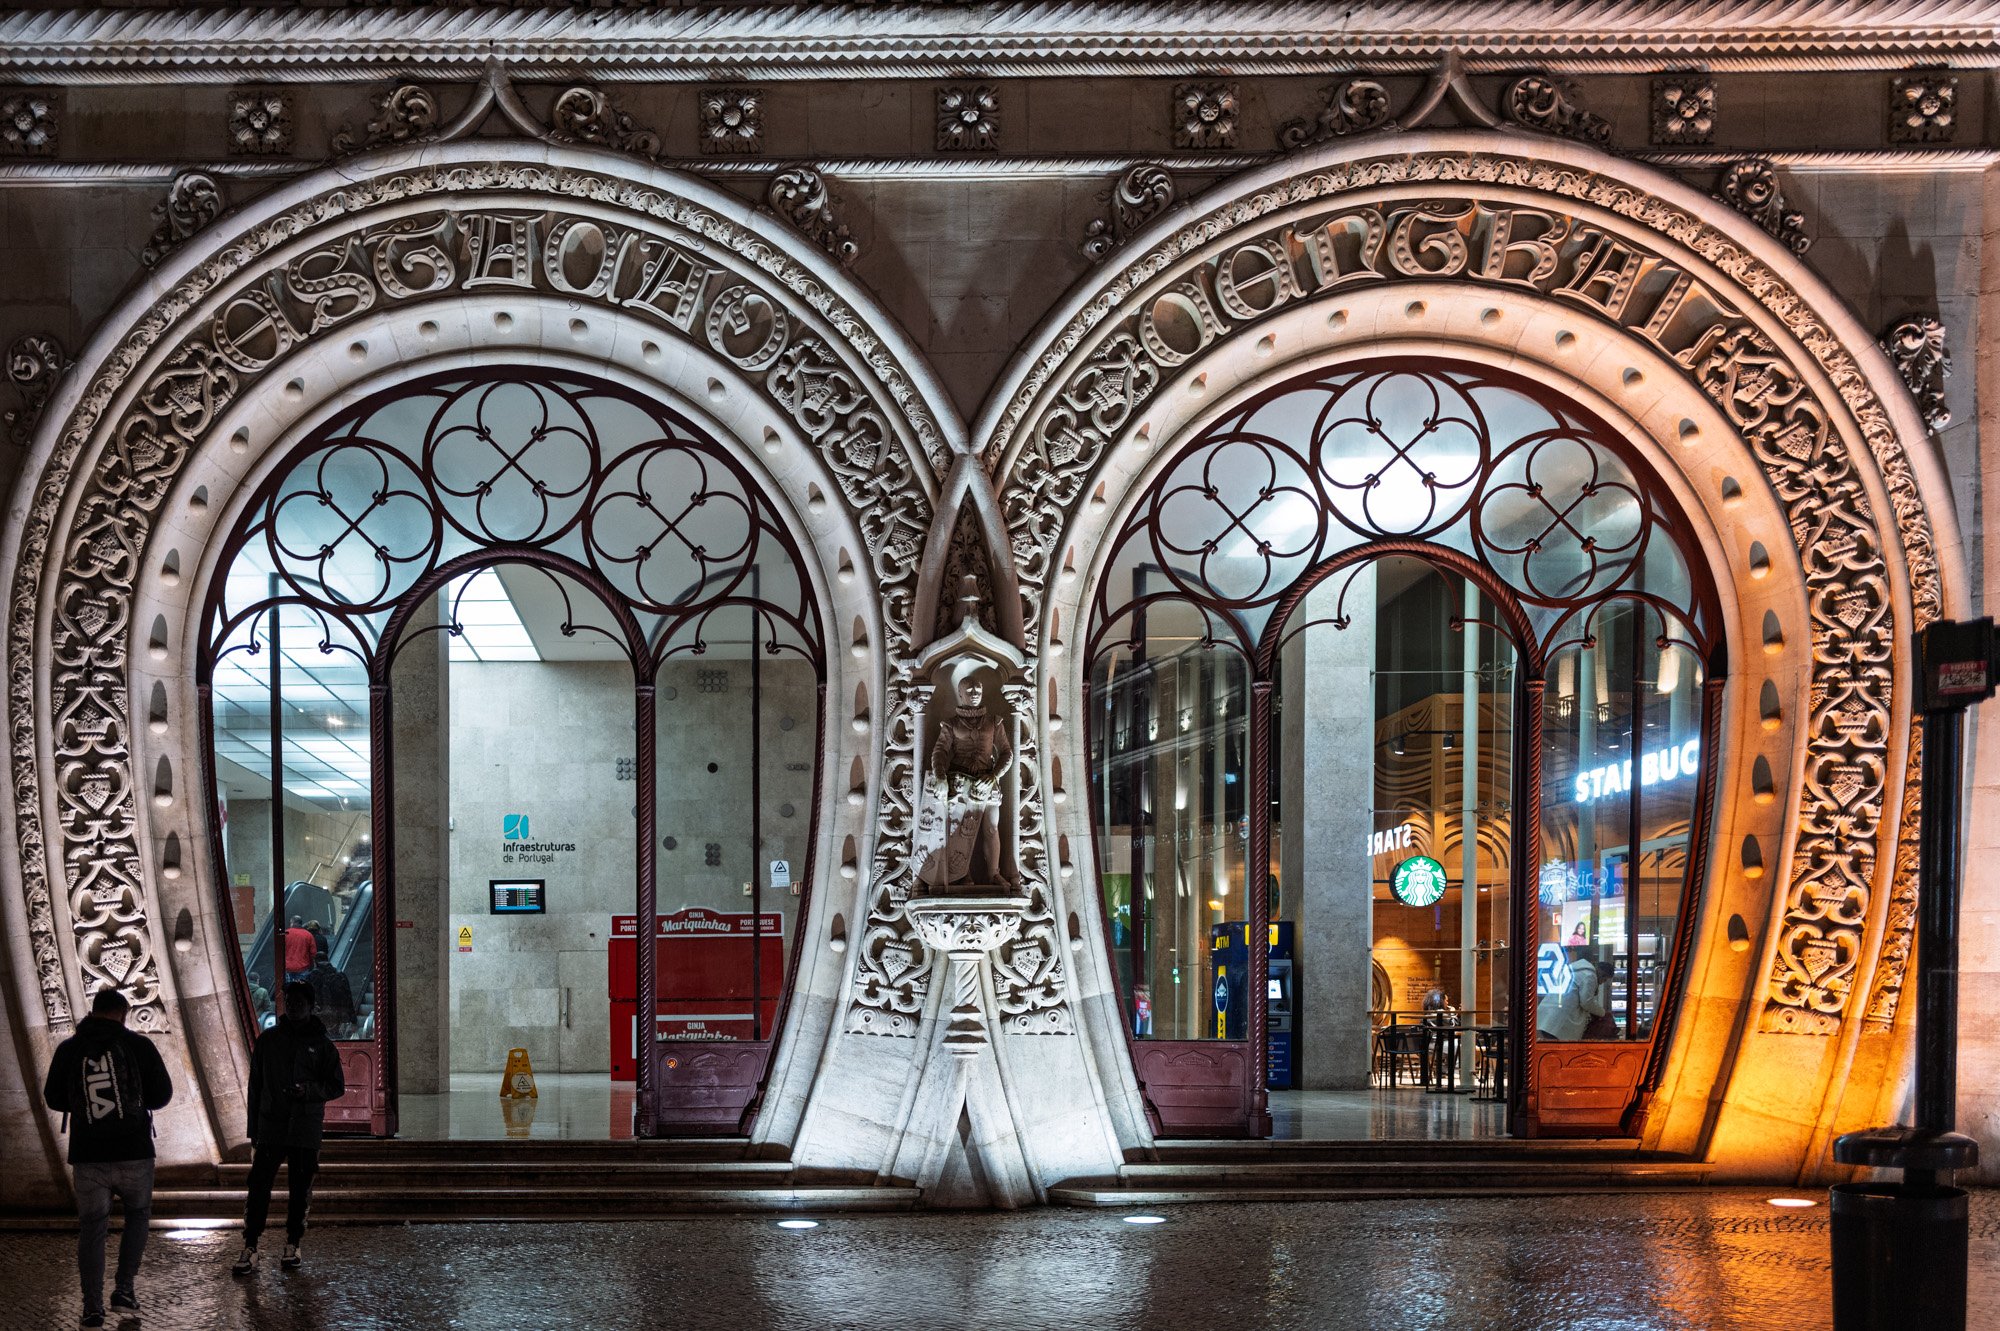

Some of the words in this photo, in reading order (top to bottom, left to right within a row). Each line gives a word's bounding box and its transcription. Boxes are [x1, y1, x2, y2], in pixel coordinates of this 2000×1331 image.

[503, 842, 576, 852] Infraestruturas
[503, 854, 514, 863] de
[518, 853, 554, 864] Portugal
[688, 911, 704, 919] GINJA
[661, 918, 731, 933] Mariquinhas
[1215, 935, 1230, 949] ATM
[687, 1021, 706, 1030] GINJA
[86, 1054, 116, 1119] FILA
